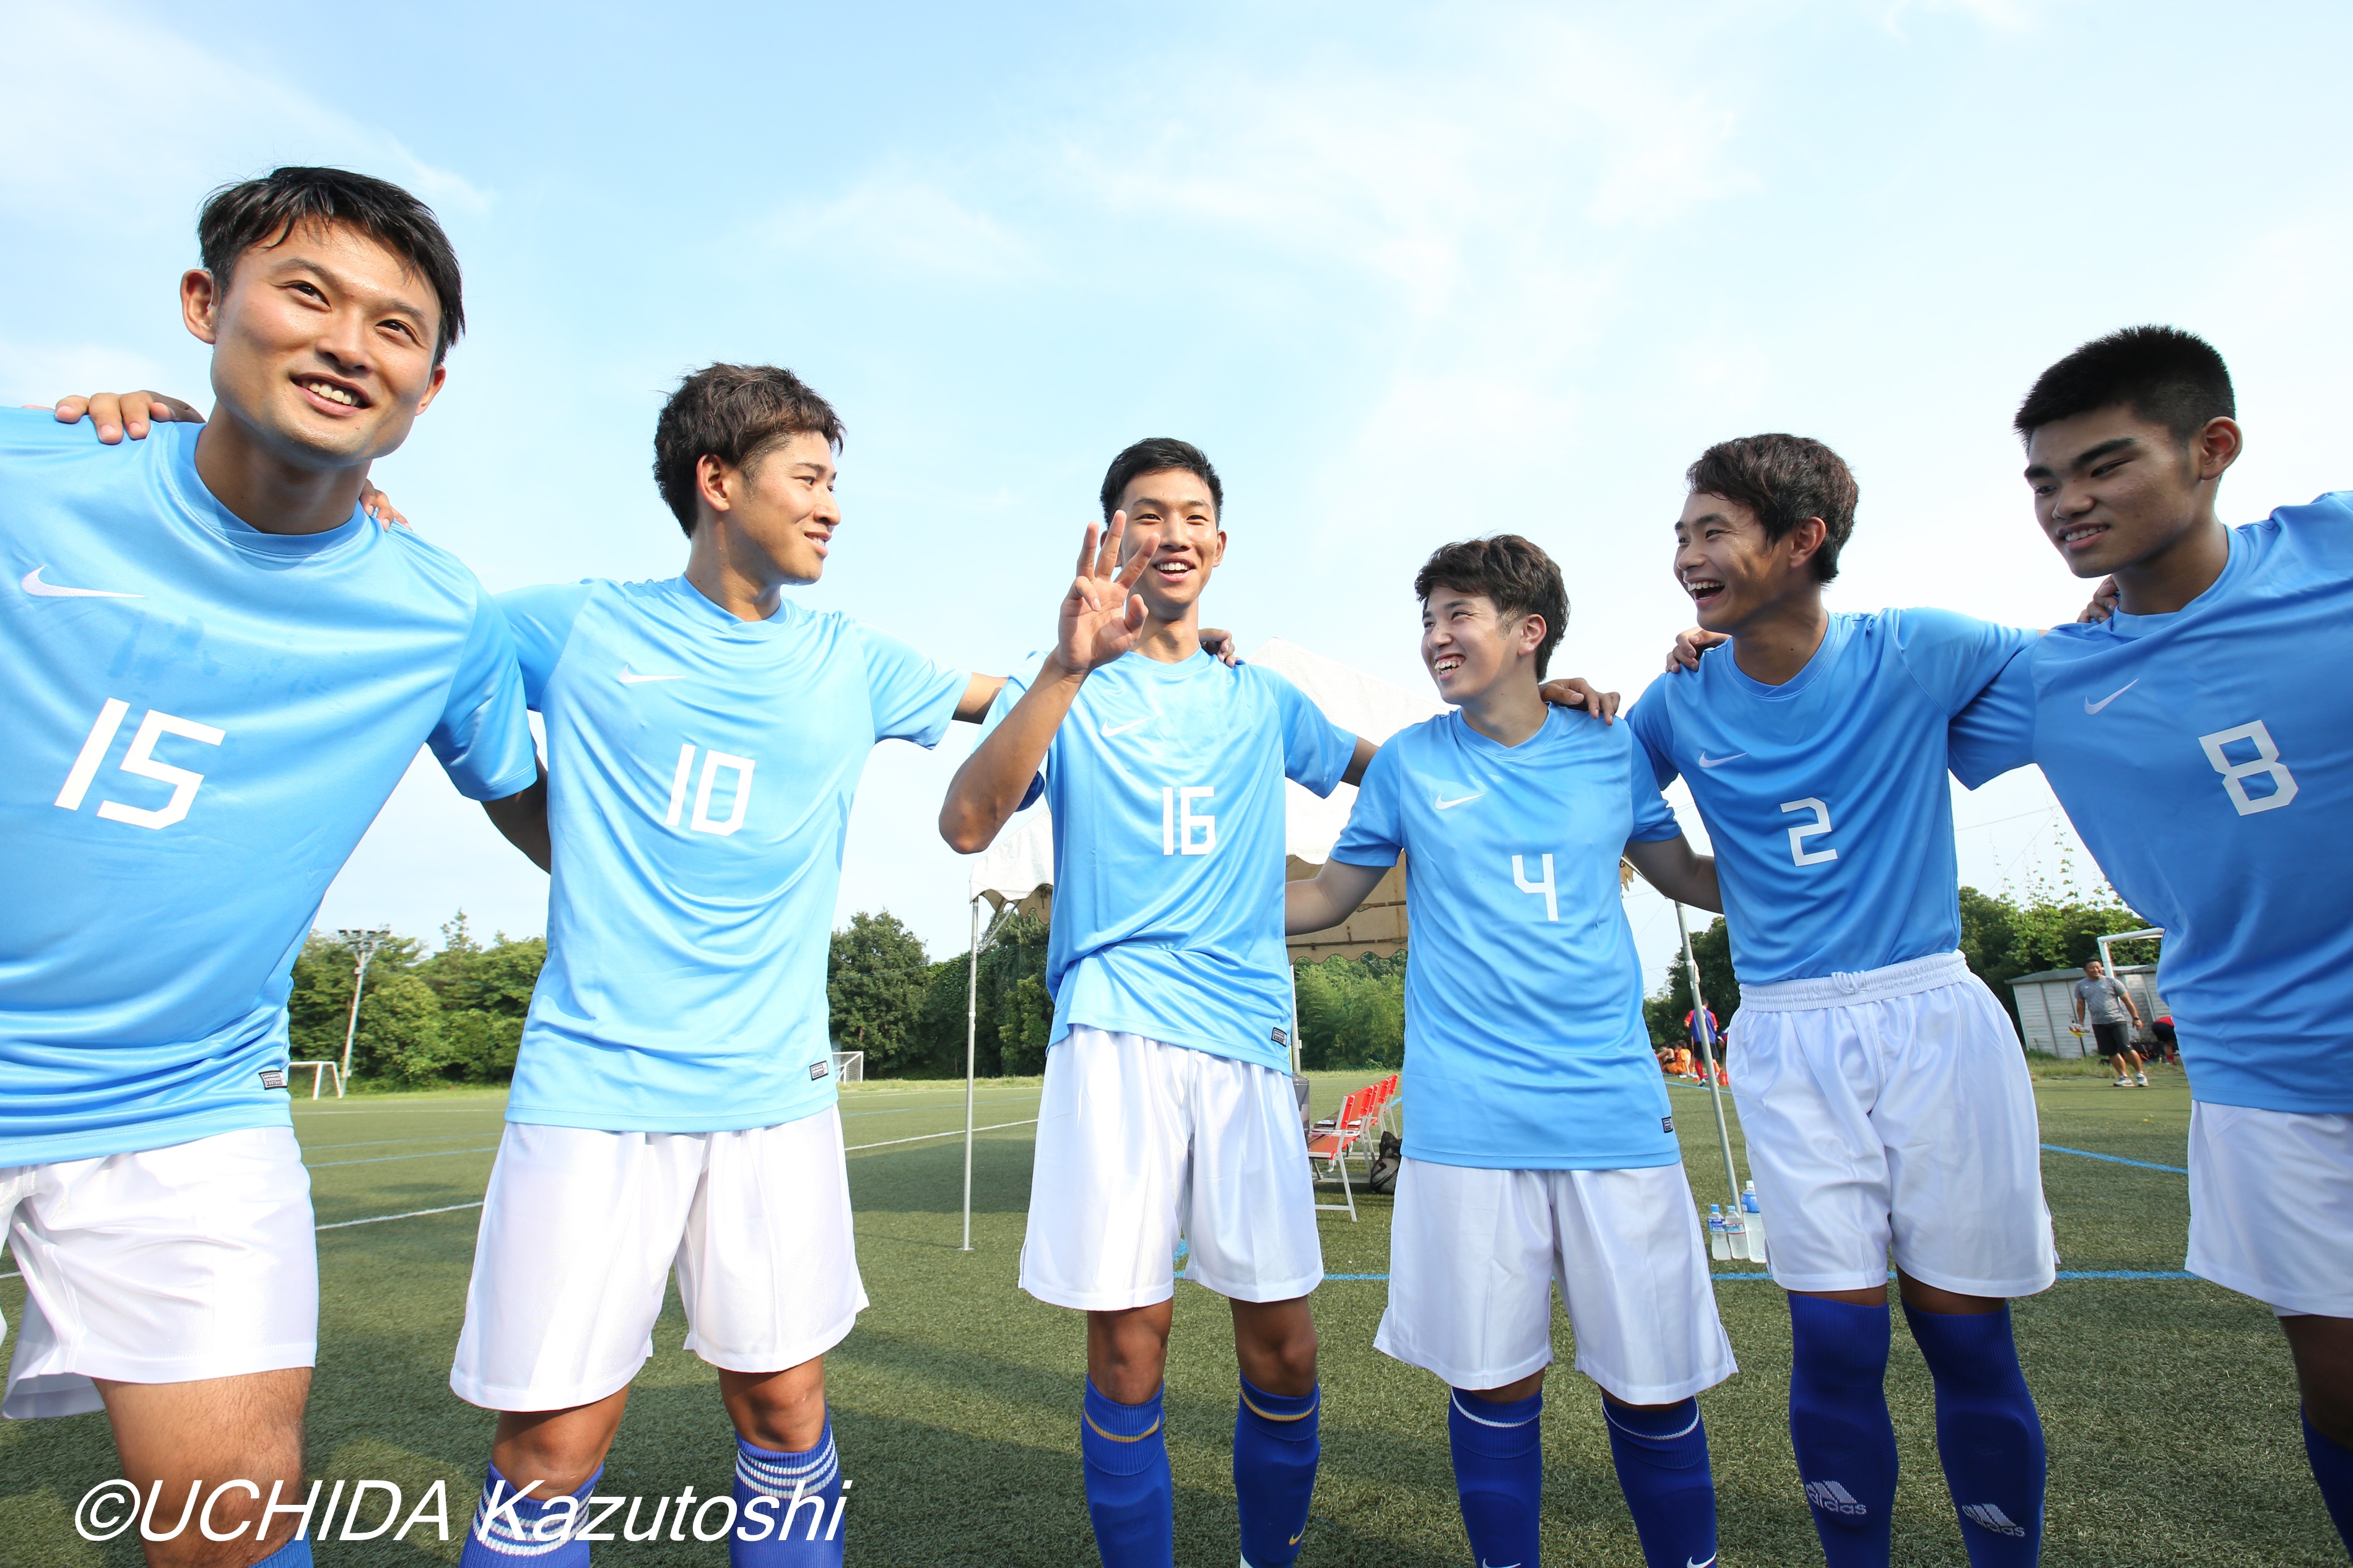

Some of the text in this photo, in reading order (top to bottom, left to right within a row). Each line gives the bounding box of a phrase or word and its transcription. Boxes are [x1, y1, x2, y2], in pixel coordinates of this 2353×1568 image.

[54, 697, 226, 830] 15
[665, 743, 755, 836] 10
[2198, 719, 2299, 816] 8
[1162, 786, 1216, 855] 16
[1780, 797, 1838, 867] 2
[1511, 853, 1559, 921] 4
